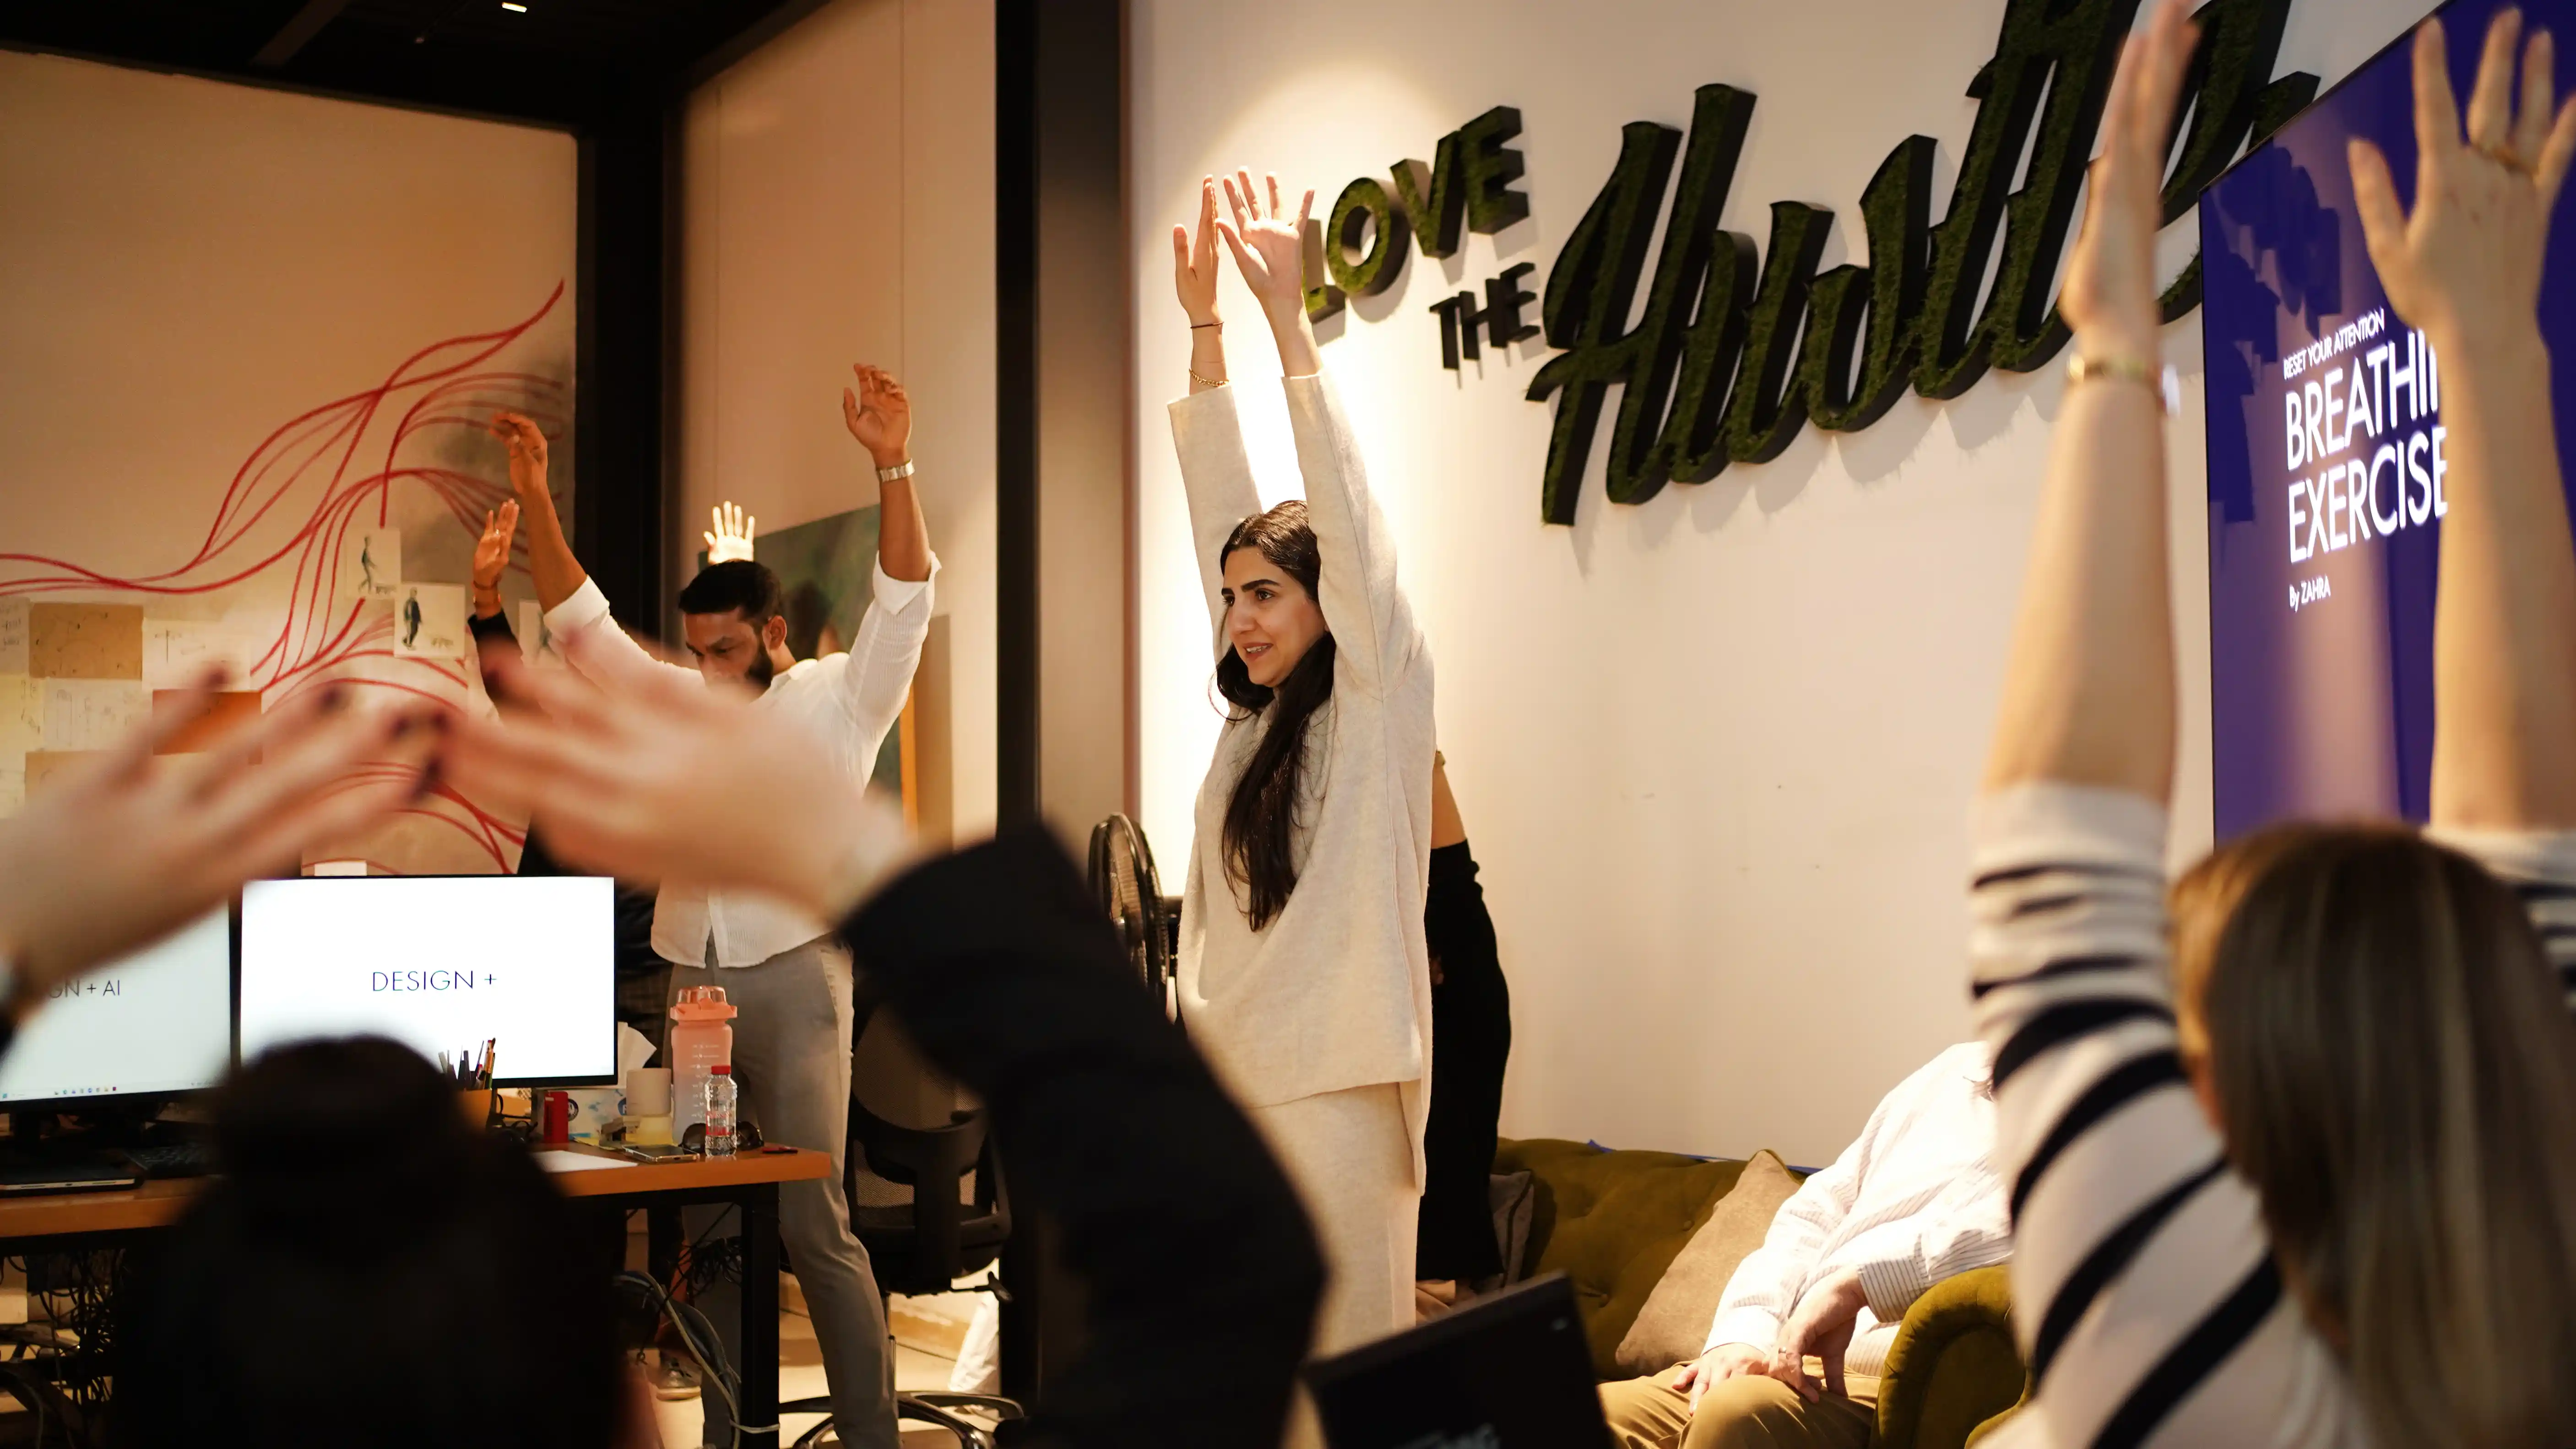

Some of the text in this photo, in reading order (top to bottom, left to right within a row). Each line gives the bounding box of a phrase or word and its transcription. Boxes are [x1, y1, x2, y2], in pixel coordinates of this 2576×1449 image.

[1429, 262, 1540, 370] THE
[2283, 306, 2385, 380] RESET YOUR ATTENTION
[2289, 429, 2448, 563] EXERCISE
[2289, 574, 2331, 613] By ZAHRA
[103, 979, 119, 996] AI
[373, 970, 473, 991] DESIGN
